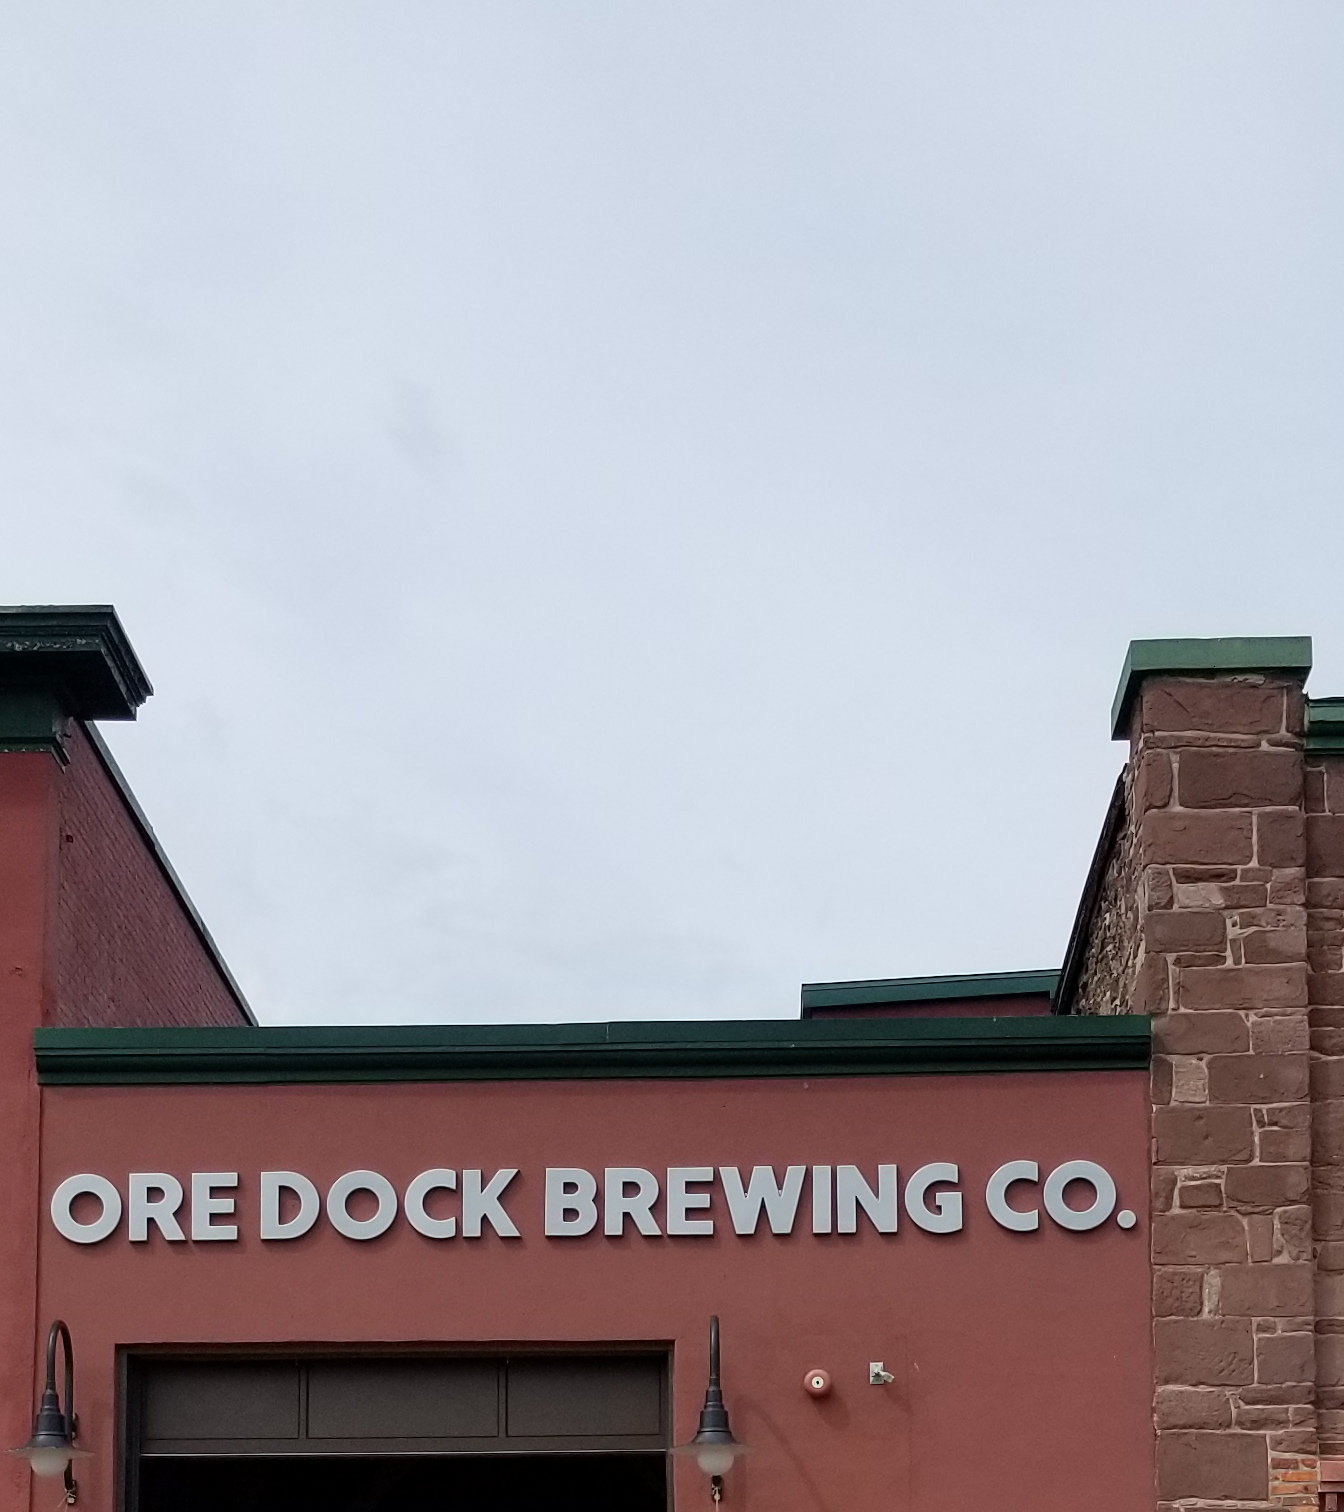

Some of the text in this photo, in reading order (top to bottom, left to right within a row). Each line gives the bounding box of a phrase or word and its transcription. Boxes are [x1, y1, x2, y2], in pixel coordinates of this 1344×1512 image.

[51, 1158, 1138, 1245] ORE DOCK BREWING CO.
